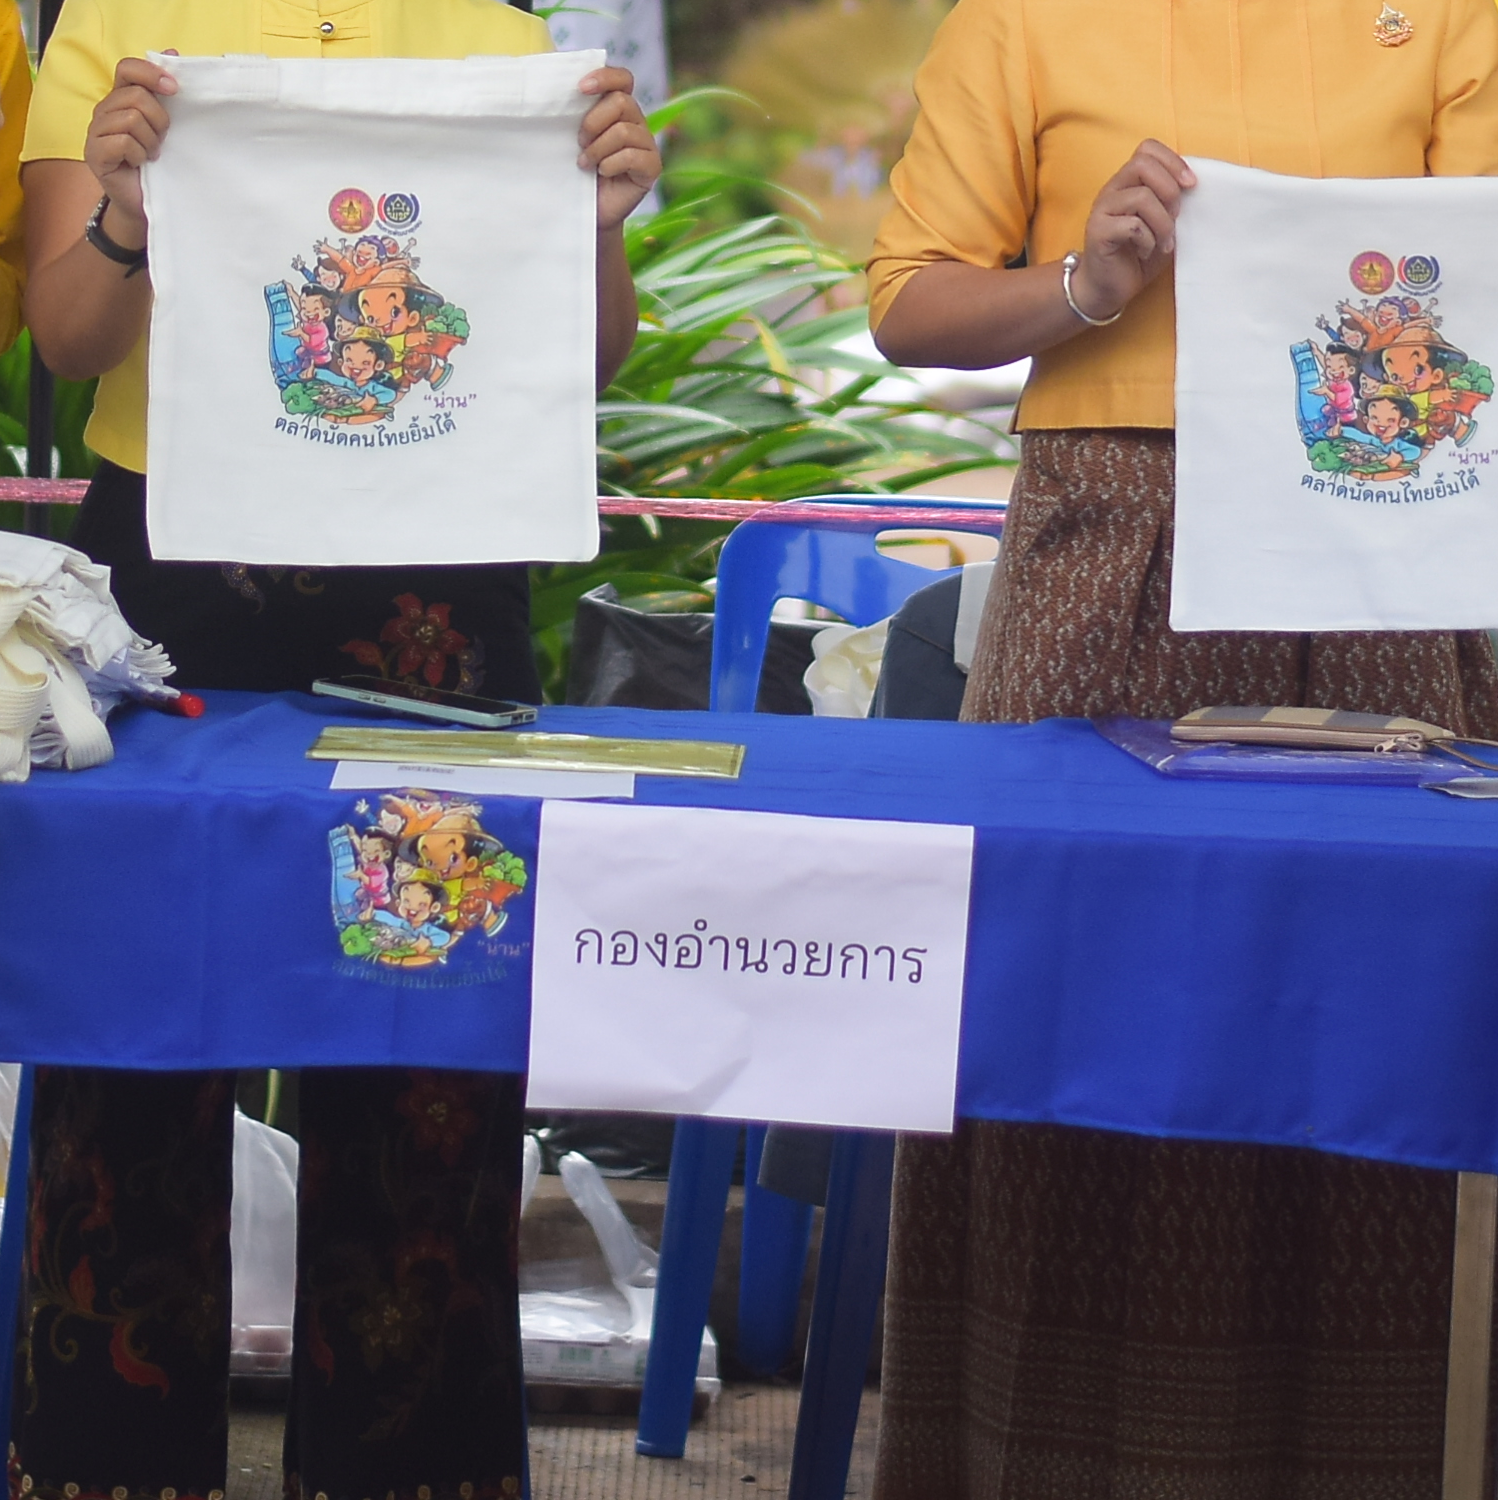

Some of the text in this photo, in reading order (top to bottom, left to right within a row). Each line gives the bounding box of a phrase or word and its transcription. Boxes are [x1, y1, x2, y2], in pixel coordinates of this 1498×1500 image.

[423, 392, 478, 411] “น่าน”
[274, 411, 457, 449] ตลาดนัดคนไทยยิ้มได้
[1448, 448, 1498, 466] “น่าน”
[1300, 468, 1480, 504] ตลาดนัดคนไทยยิ้มได้
[573, 919, 928, 984] กองอำนวยการ
